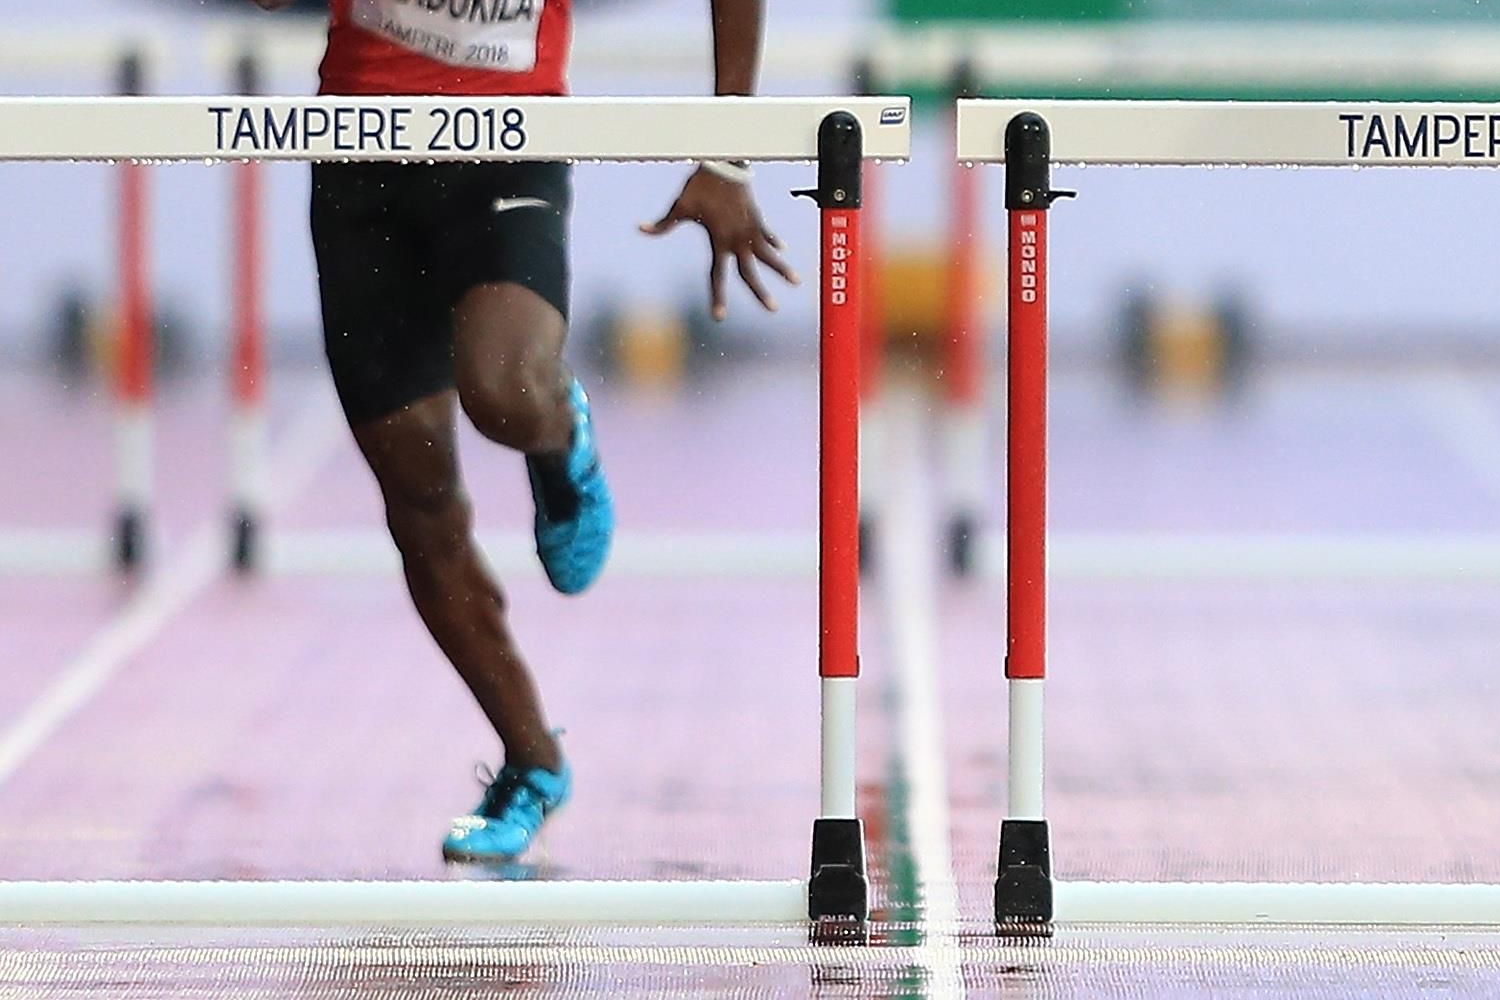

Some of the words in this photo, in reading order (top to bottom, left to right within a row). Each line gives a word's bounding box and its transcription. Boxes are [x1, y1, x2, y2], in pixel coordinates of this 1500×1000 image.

[208, 107, 411, 150] TAMPERE
[428, 107, 527, 151] 2018
[832, 231, 846, 305] MONDO
[1021, 230, 1036, 303] MONDO
